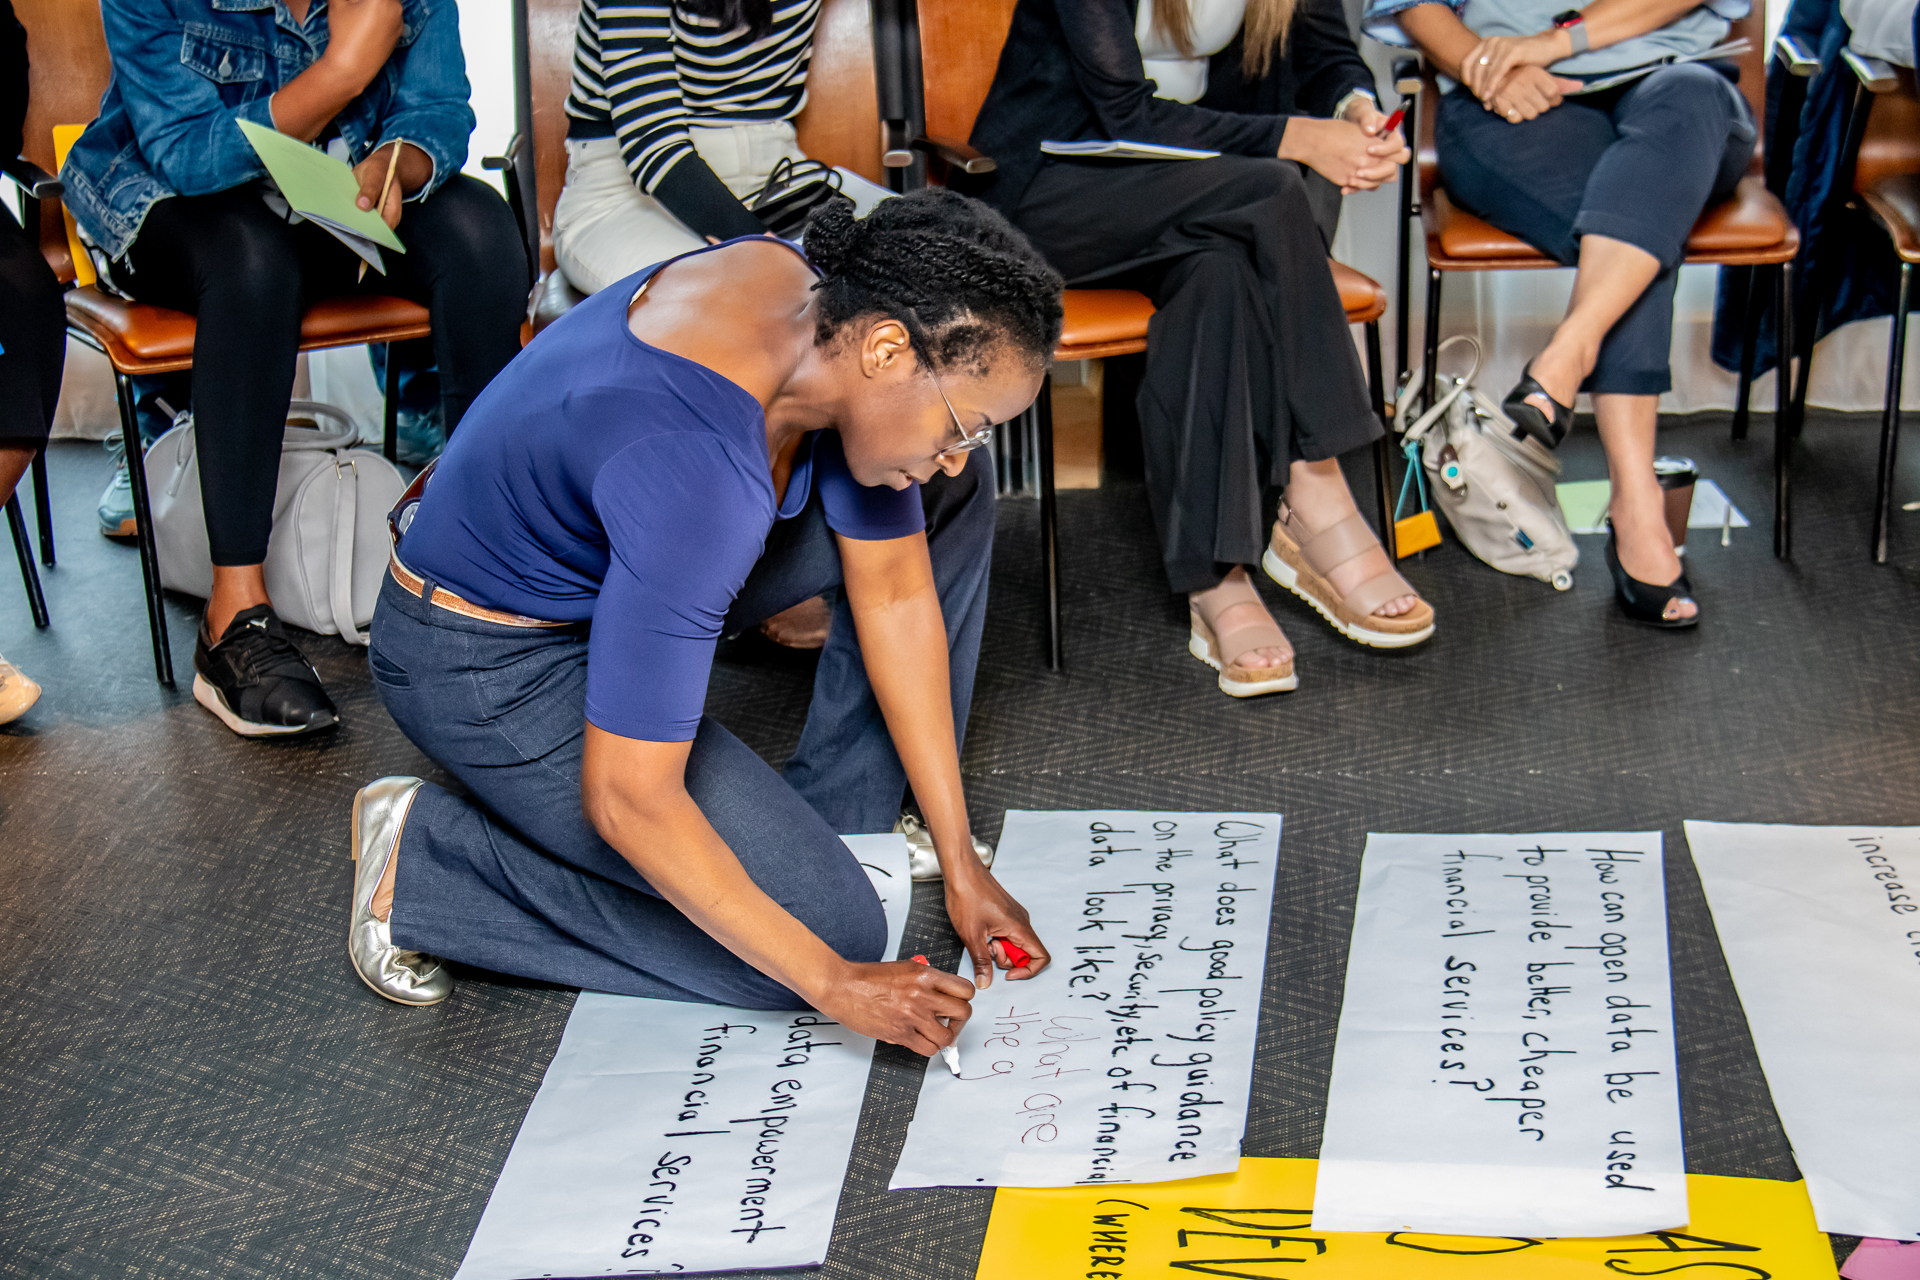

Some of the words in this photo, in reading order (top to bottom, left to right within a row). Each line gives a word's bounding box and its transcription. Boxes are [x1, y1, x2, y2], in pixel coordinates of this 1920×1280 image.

[1090, 822, 1141, 866] data
[1156, 848, 1193, 872] the
[1214, 821, 1266, 869] What
[1517, 846, 1568, 866] to
[1586, 849, 1644, 884] How
[1441, 850, 1503, 937] financial
[1847, 835, 1918, 915] increase
[1078, 891, 1136, 931] look
[1216, 882, 1257, 926] does
[1503, 875, 1572, 943] provide
[1601, 892, 1625, 923] can
[1068, 946, 1115, 1001] like?
[1179, 936, 1243, 980] good
[1564, 932, 1628, 982] open
[1158, 988, 1237, 1042] policy
[1521, 962, 1574, 1019] better,
[776, 1016, 843, 1067] data
[984, 1006, 1042, 1048] the
[1031, 1016, 1100, 1079] What
[1432, 956, 1496, 1092] services?
[1605, 995, 1658, 1053] data
[664, 1023, 757, 1136] financial
[1108, 1067, 1157, 1095] of
[1485, 1032, 1577, 1142] cheaper
[1604, 1072, 1660, 1104] be
[1016, 1093, 1062, 1144] are
[1151, 1052, 1224, 1162] guidance
[729, 1080, 802, 1244] empowerment
[1075, 1102, 1156, 1184] financial
[1605, 1131, 1656, 1191] used
